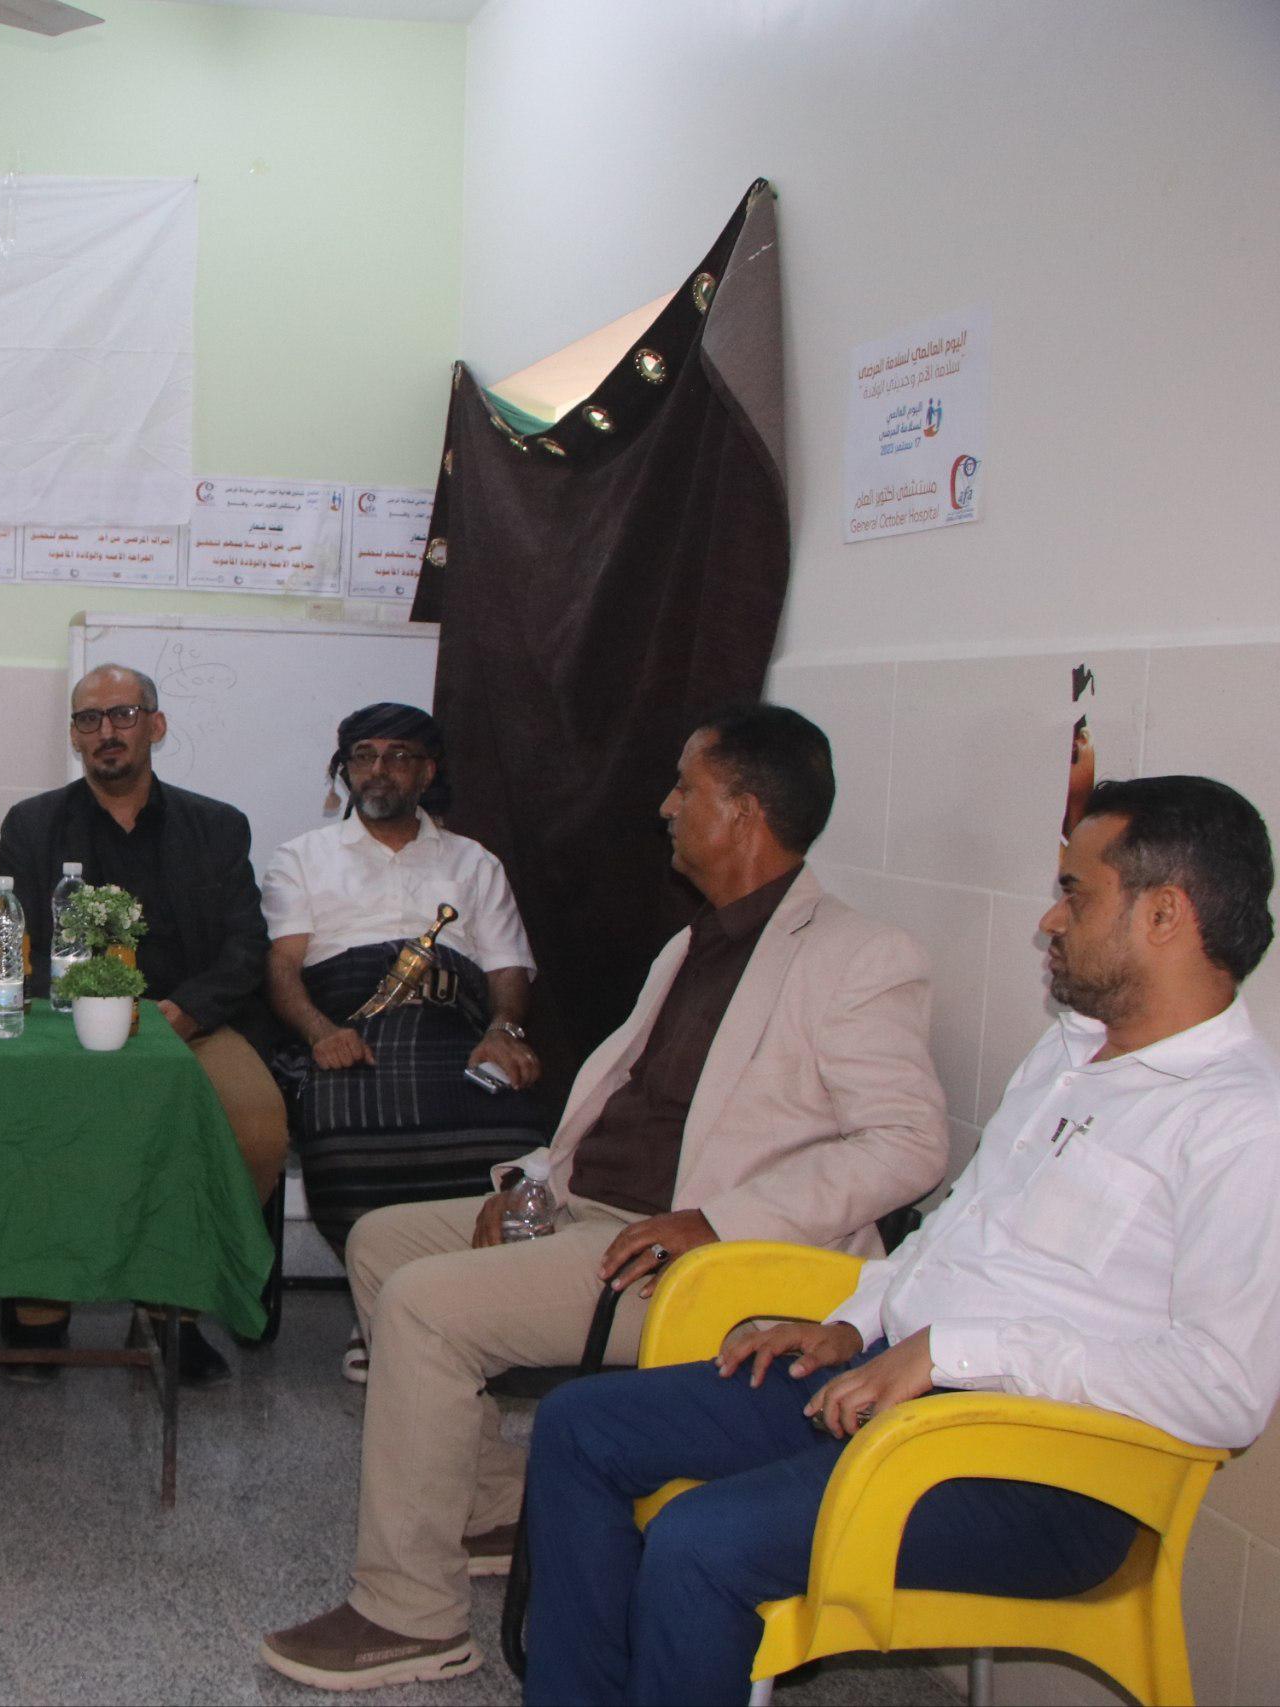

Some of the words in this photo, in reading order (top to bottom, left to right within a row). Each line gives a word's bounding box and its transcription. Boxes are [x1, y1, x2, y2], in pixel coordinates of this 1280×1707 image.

[911, 337, 943, 366] العالمي
[945, 331, 967, 355] اليوم
[885, 348, 910, 370] لسلامة
[886, 406, 907, 424] العالمي
[907, 401, 924, 418] اليوم
[850, 516, 878, 534] General
[879, 512, 908, 529] October
[909, 503, 940, 524] Hospital
